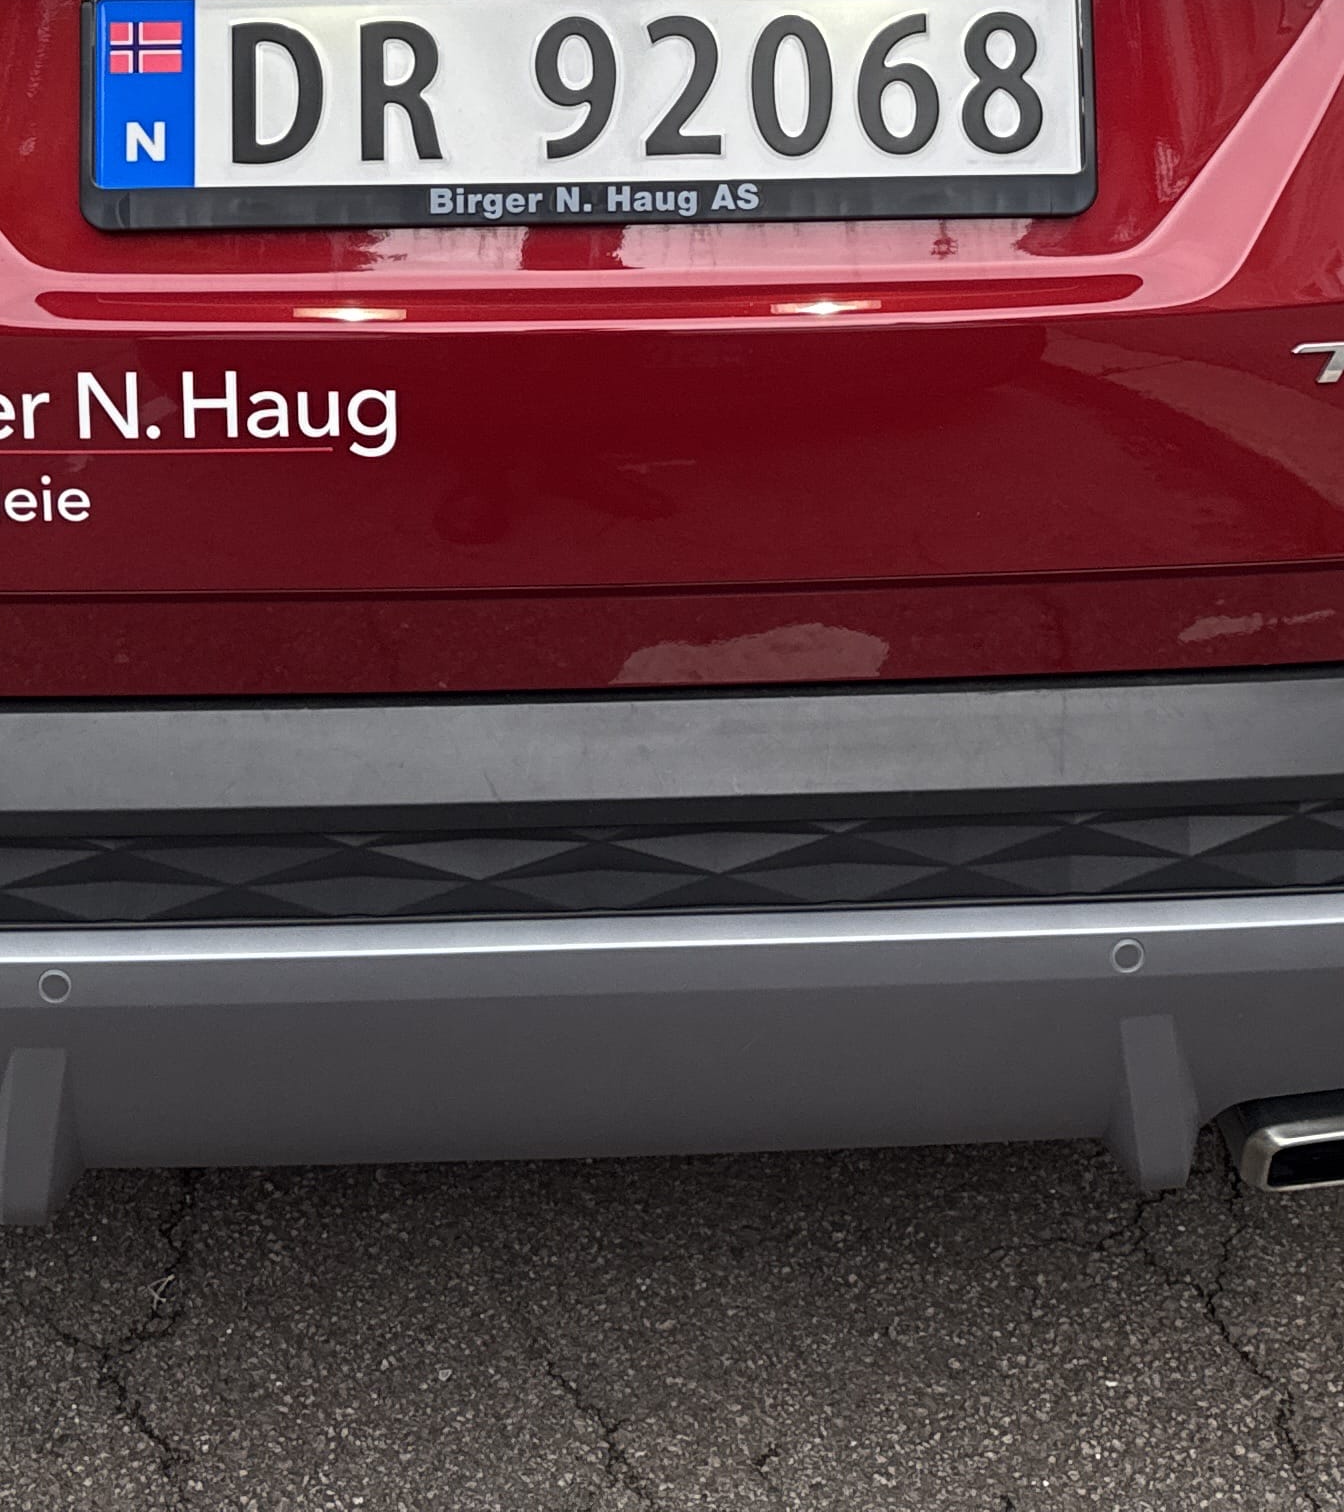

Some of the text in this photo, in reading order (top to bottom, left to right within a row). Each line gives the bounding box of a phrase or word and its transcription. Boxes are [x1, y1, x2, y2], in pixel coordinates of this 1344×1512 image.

[231, 12, 1044, 163] DR 92068
[126, 120, 167, 162] N
[429, 183, 759, 219] Birger N. Haug AS
[77, 370, 161, 440] N.
[182, 369, 397, 458] Haug
